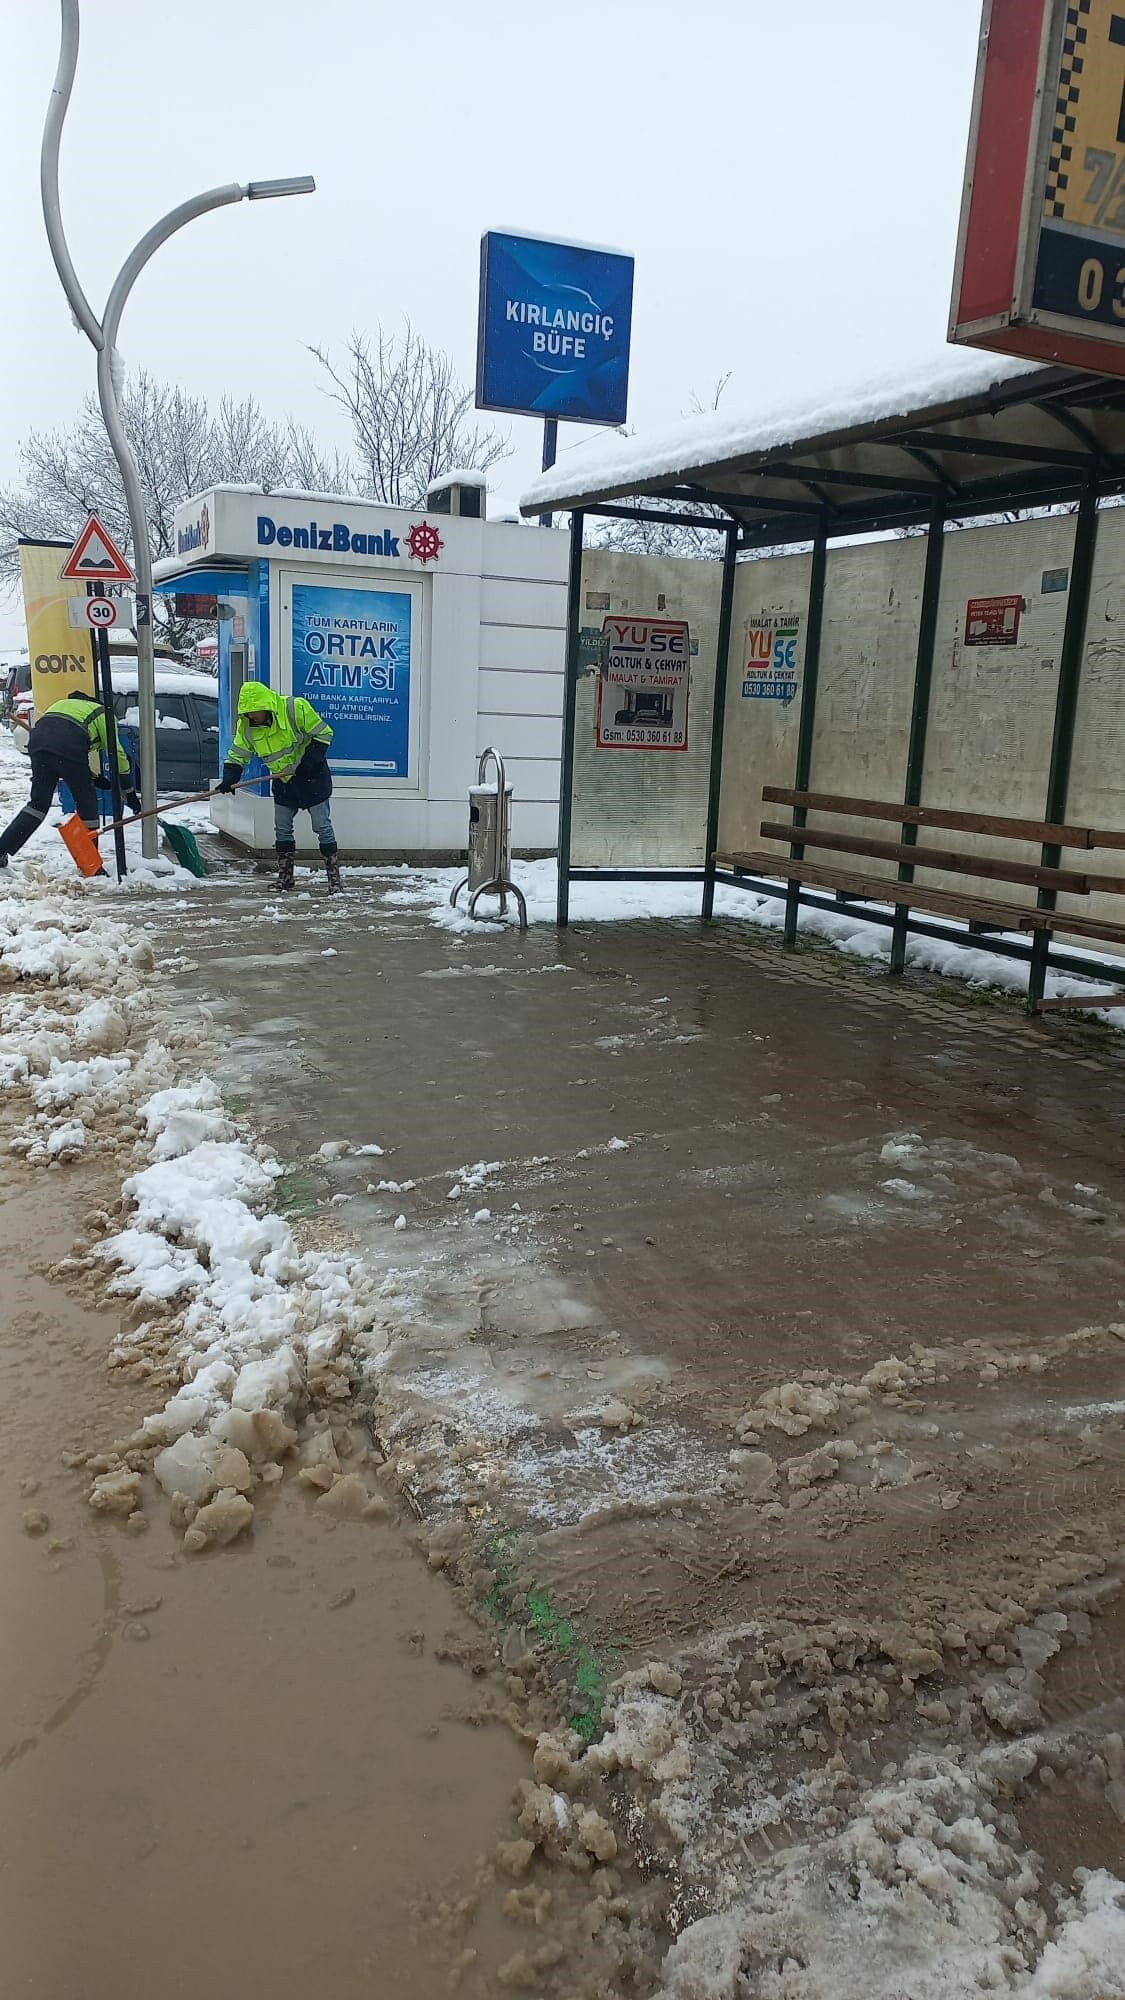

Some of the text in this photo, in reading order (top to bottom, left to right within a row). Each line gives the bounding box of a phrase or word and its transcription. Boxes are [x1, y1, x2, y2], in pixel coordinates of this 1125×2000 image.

[506, 300, 614, 341] KIRLANGIÇ
[533, 329, 586, 358] BÜFE
[257, 516, 401, 558] DenizBank
[92, 607, 110, 618] 30
[305, 613, 399, 633] TÜM KARTLARIN
[305, 631, 398, 660] ORTAK
[608, 655, 688, 674] KOLTUK & ÇEKYAT
[303, 692, 399, 705] TÜM BANKA KARTLARIYLA
[744, 683, 761, 696] 0530
[762, 683, 775, 696] 360
[776, 684, 785, 696] 61
[329, 703, 340, 711] BU
[603, 728, 683, 744] Gsm: 0530 360 61 88
